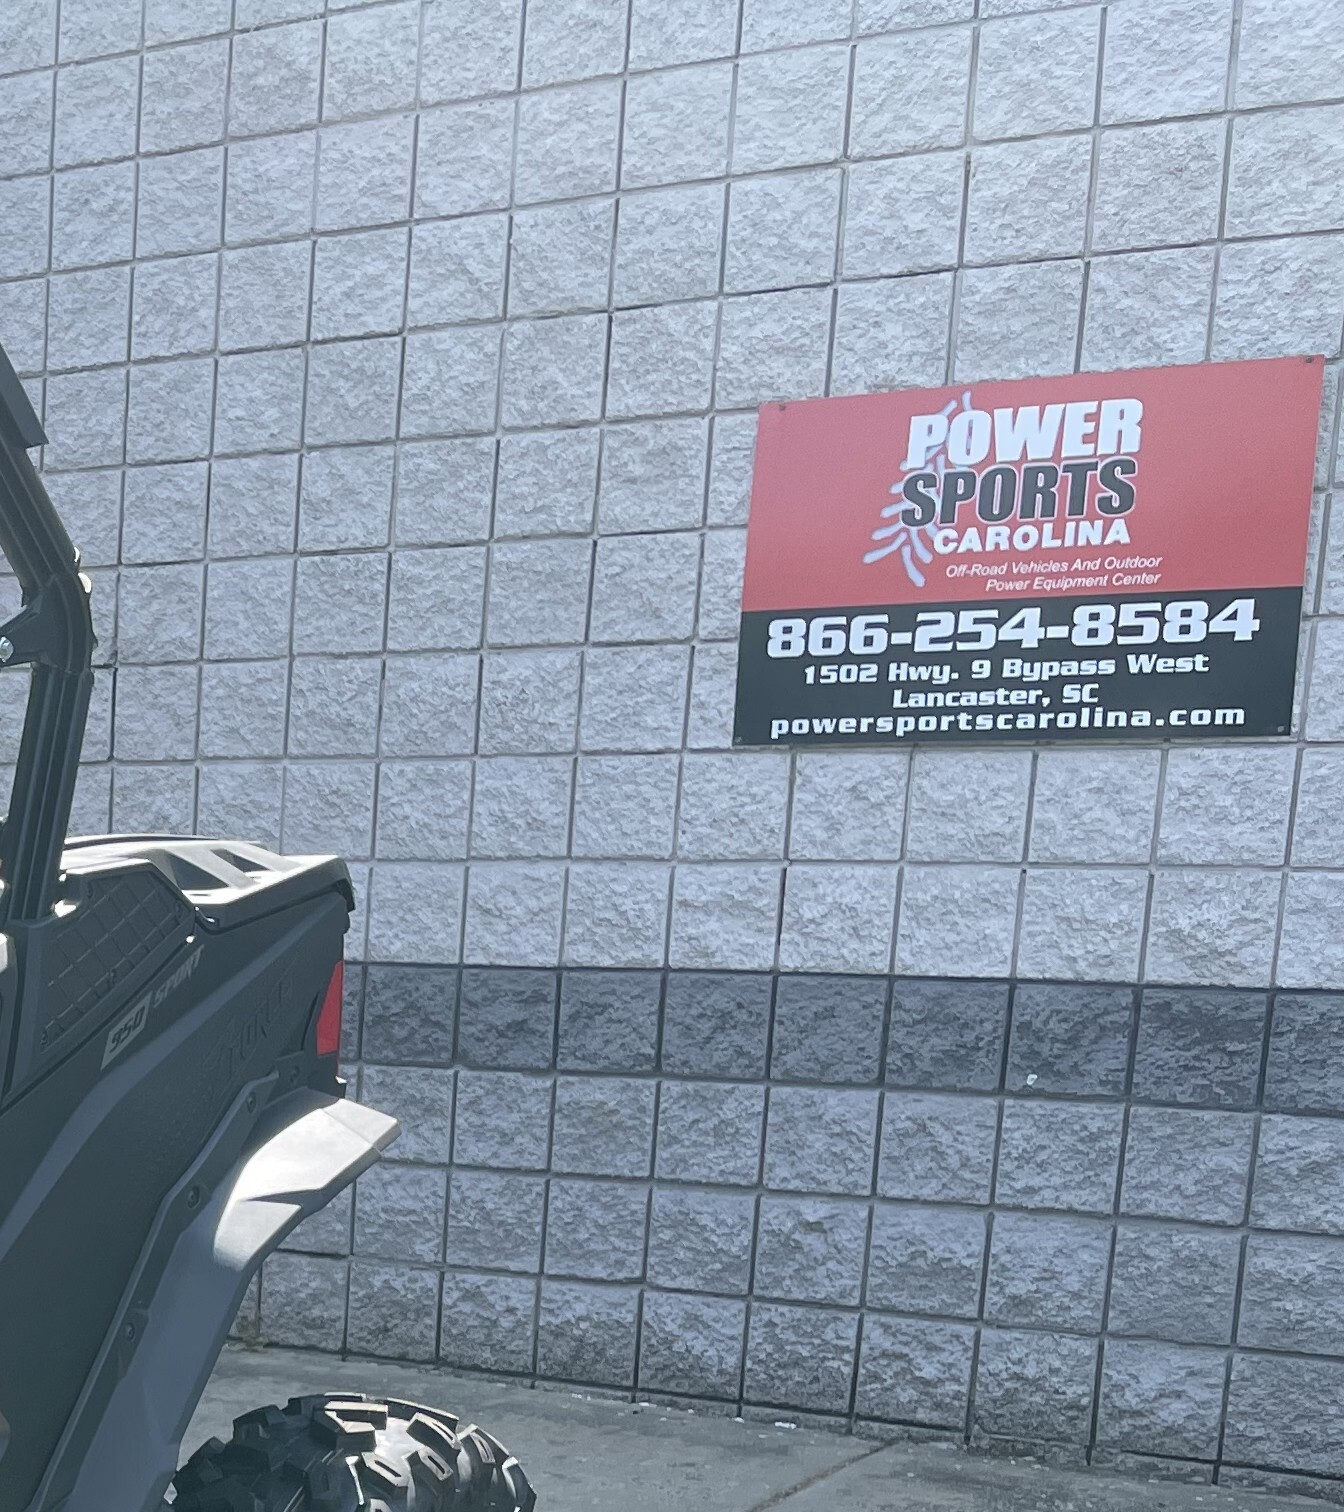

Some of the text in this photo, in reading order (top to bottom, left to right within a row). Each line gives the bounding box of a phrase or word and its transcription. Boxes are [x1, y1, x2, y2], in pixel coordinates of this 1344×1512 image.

[906, 398, 1143, 469] POWER
[901, 455, 1138, 527] SPORTS
[933, 518, 1131, 555] CAROLINA
[946, 555, 1163, 578] Off-Road Vehicles And Outdoor
[985, 572, 1161, 592] Power Equipment Center
[766, 598, 1260, 659] 866-254-8584
[803, 653, 1210, 685] 1502 Hwy. 9 Bypass West
[892, 683, 1100, 709] Lancaster, SC
[770, 706, 1246, 740] powersportscarolina.com
